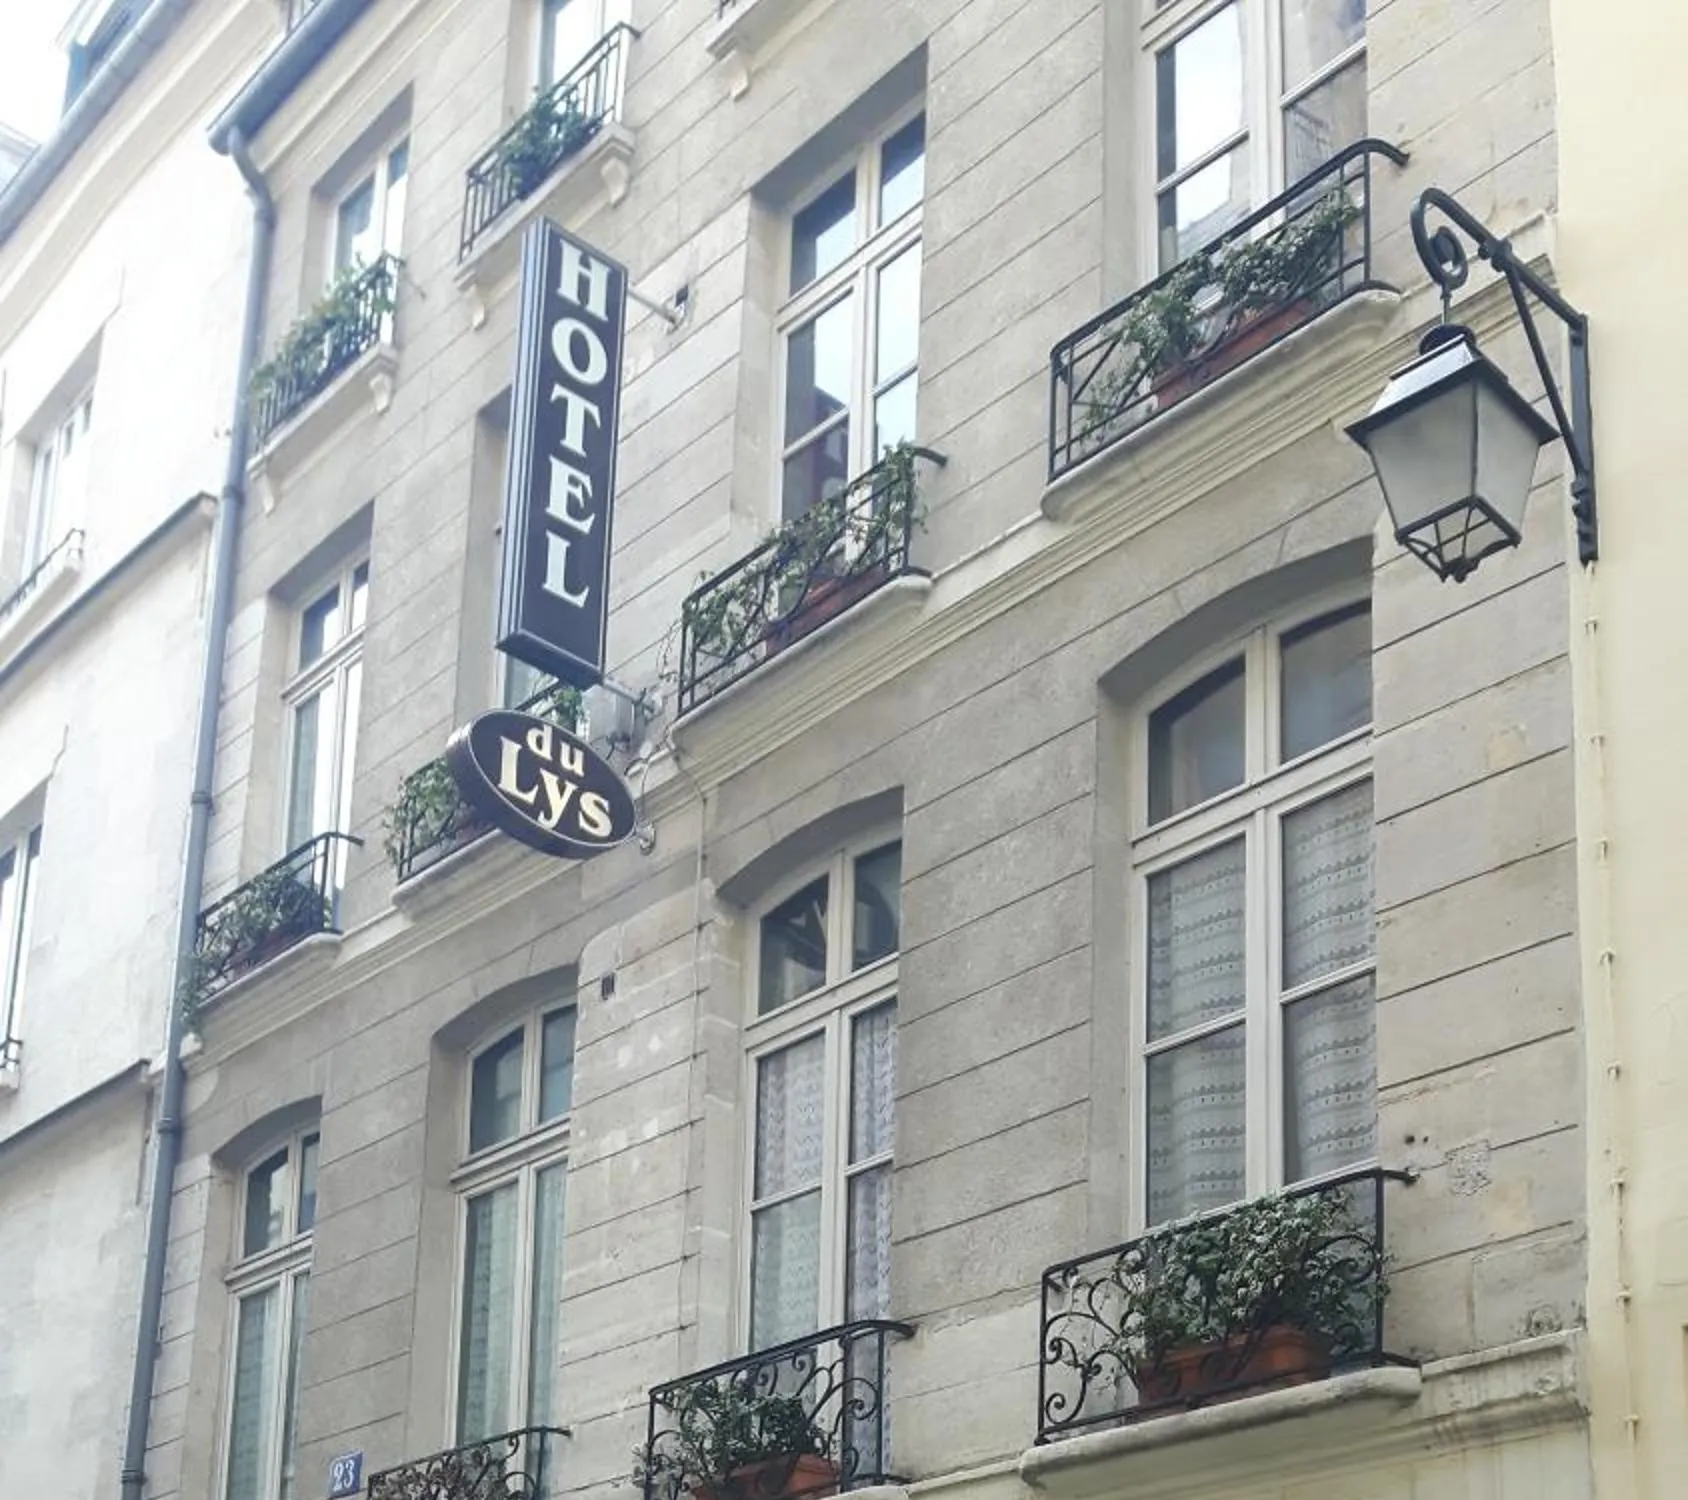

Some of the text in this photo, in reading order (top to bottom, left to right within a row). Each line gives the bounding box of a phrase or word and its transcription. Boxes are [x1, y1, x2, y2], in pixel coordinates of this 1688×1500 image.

[543, 238, 611, 608] HOTEL
[498, 737, 613, 837] Lys
[526, 724, 585, 777] du
[332, 1459, 355, 1492] 23
